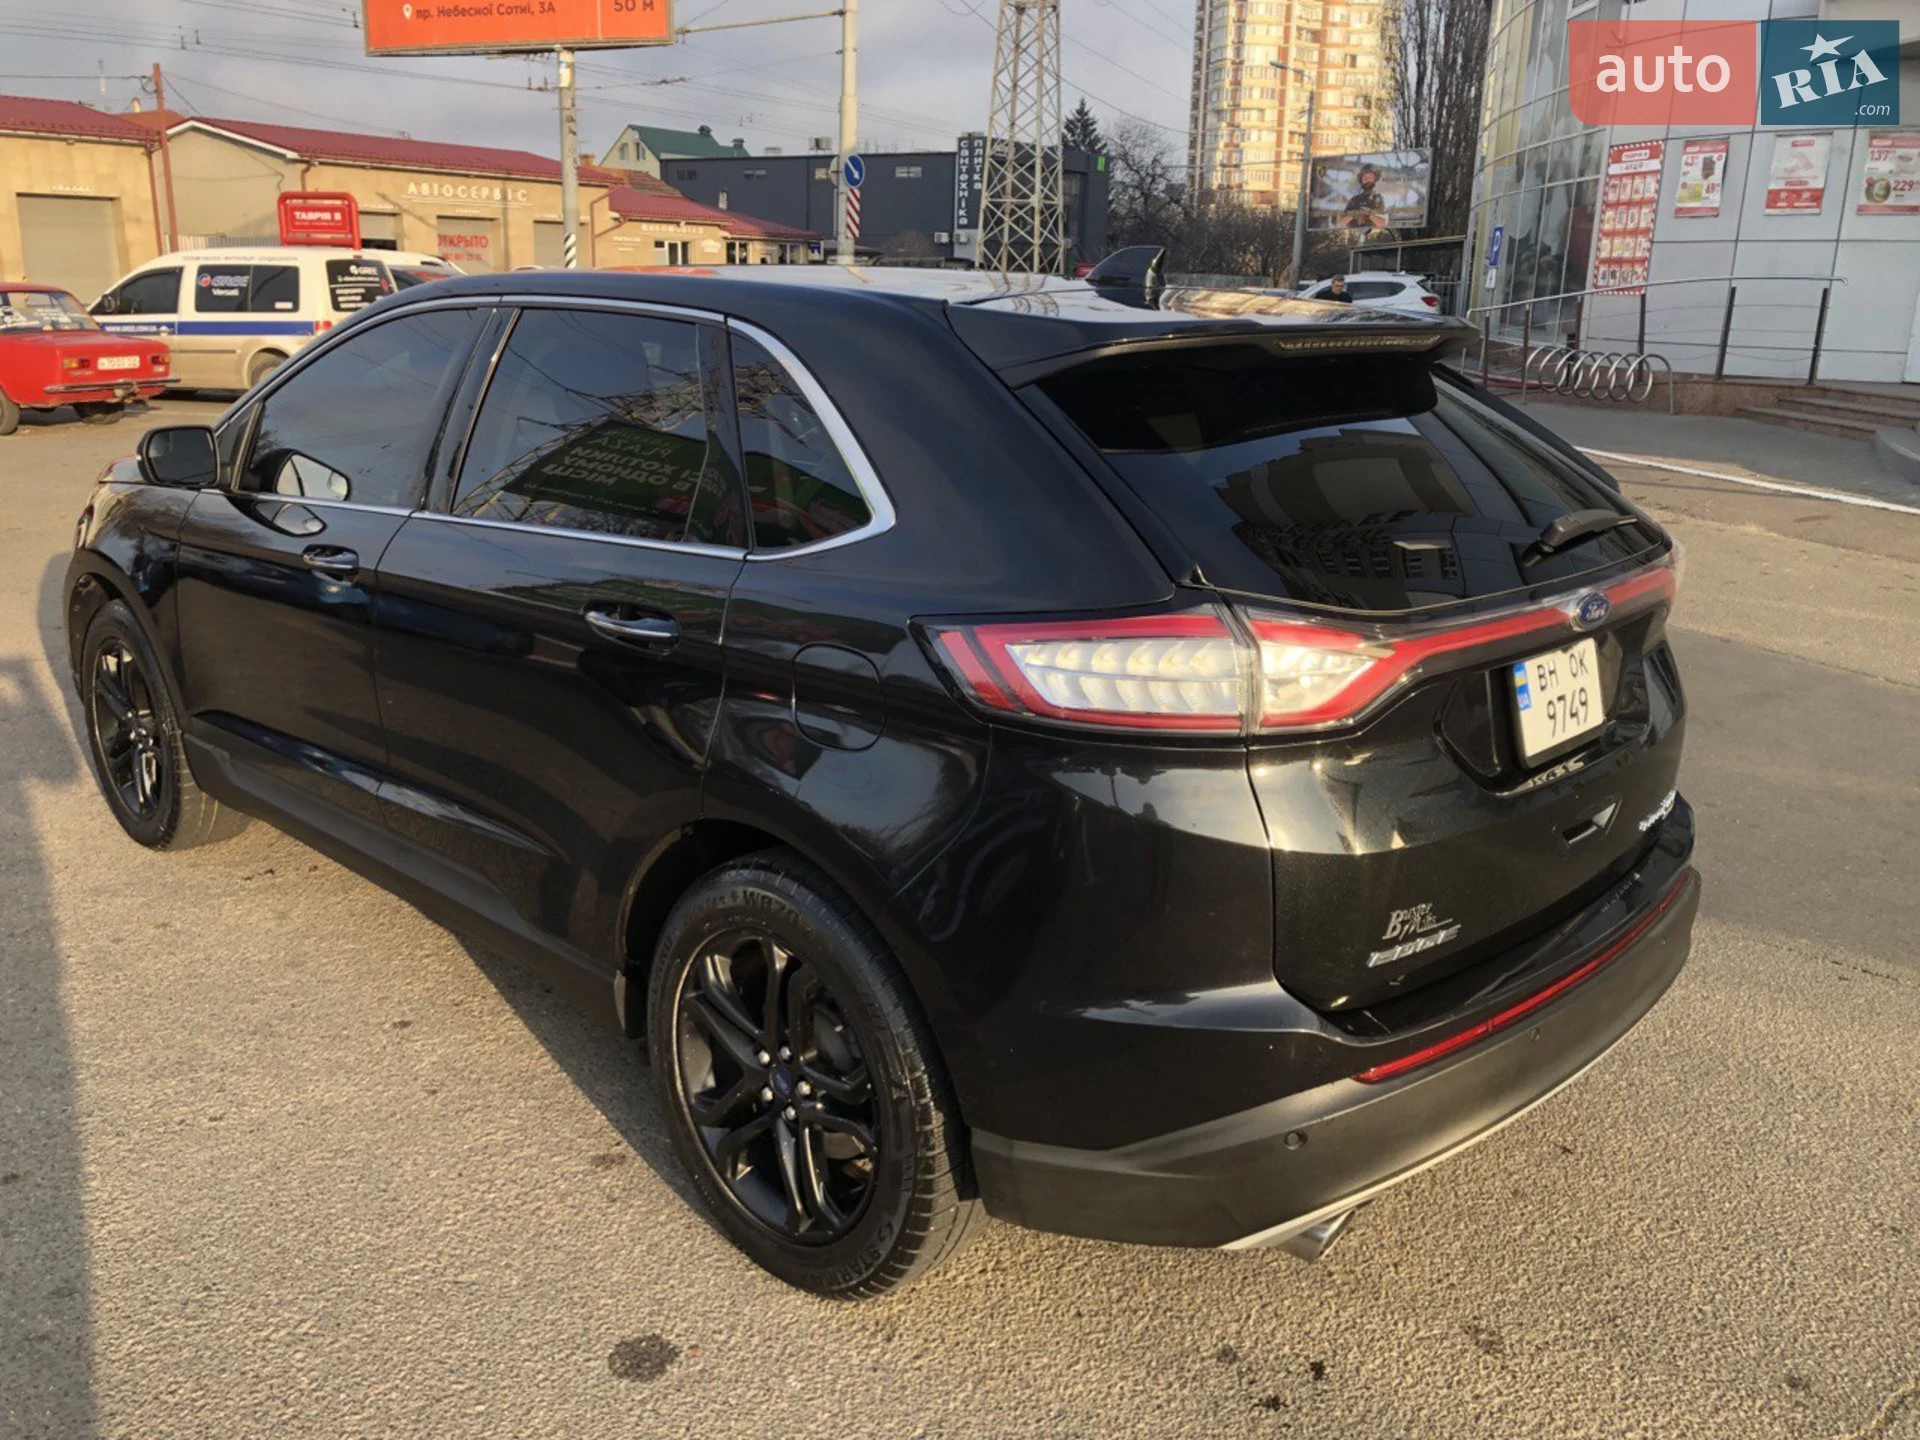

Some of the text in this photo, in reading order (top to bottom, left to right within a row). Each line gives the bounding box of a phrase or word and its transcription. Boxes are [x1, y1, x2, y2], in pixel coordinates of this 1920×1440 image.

[416, 9, 433, 20] пр.
[437, 5, 494, 18] Небесної
[496, 1, 536, 16] Сотні,
[613, 0, 637, 12] 50
[407, 181, 528, 202] АВТОСЕРВІС
[1537, 648, 1589, 692] BH OK
[1546, 686, 1588, 738] 9749
